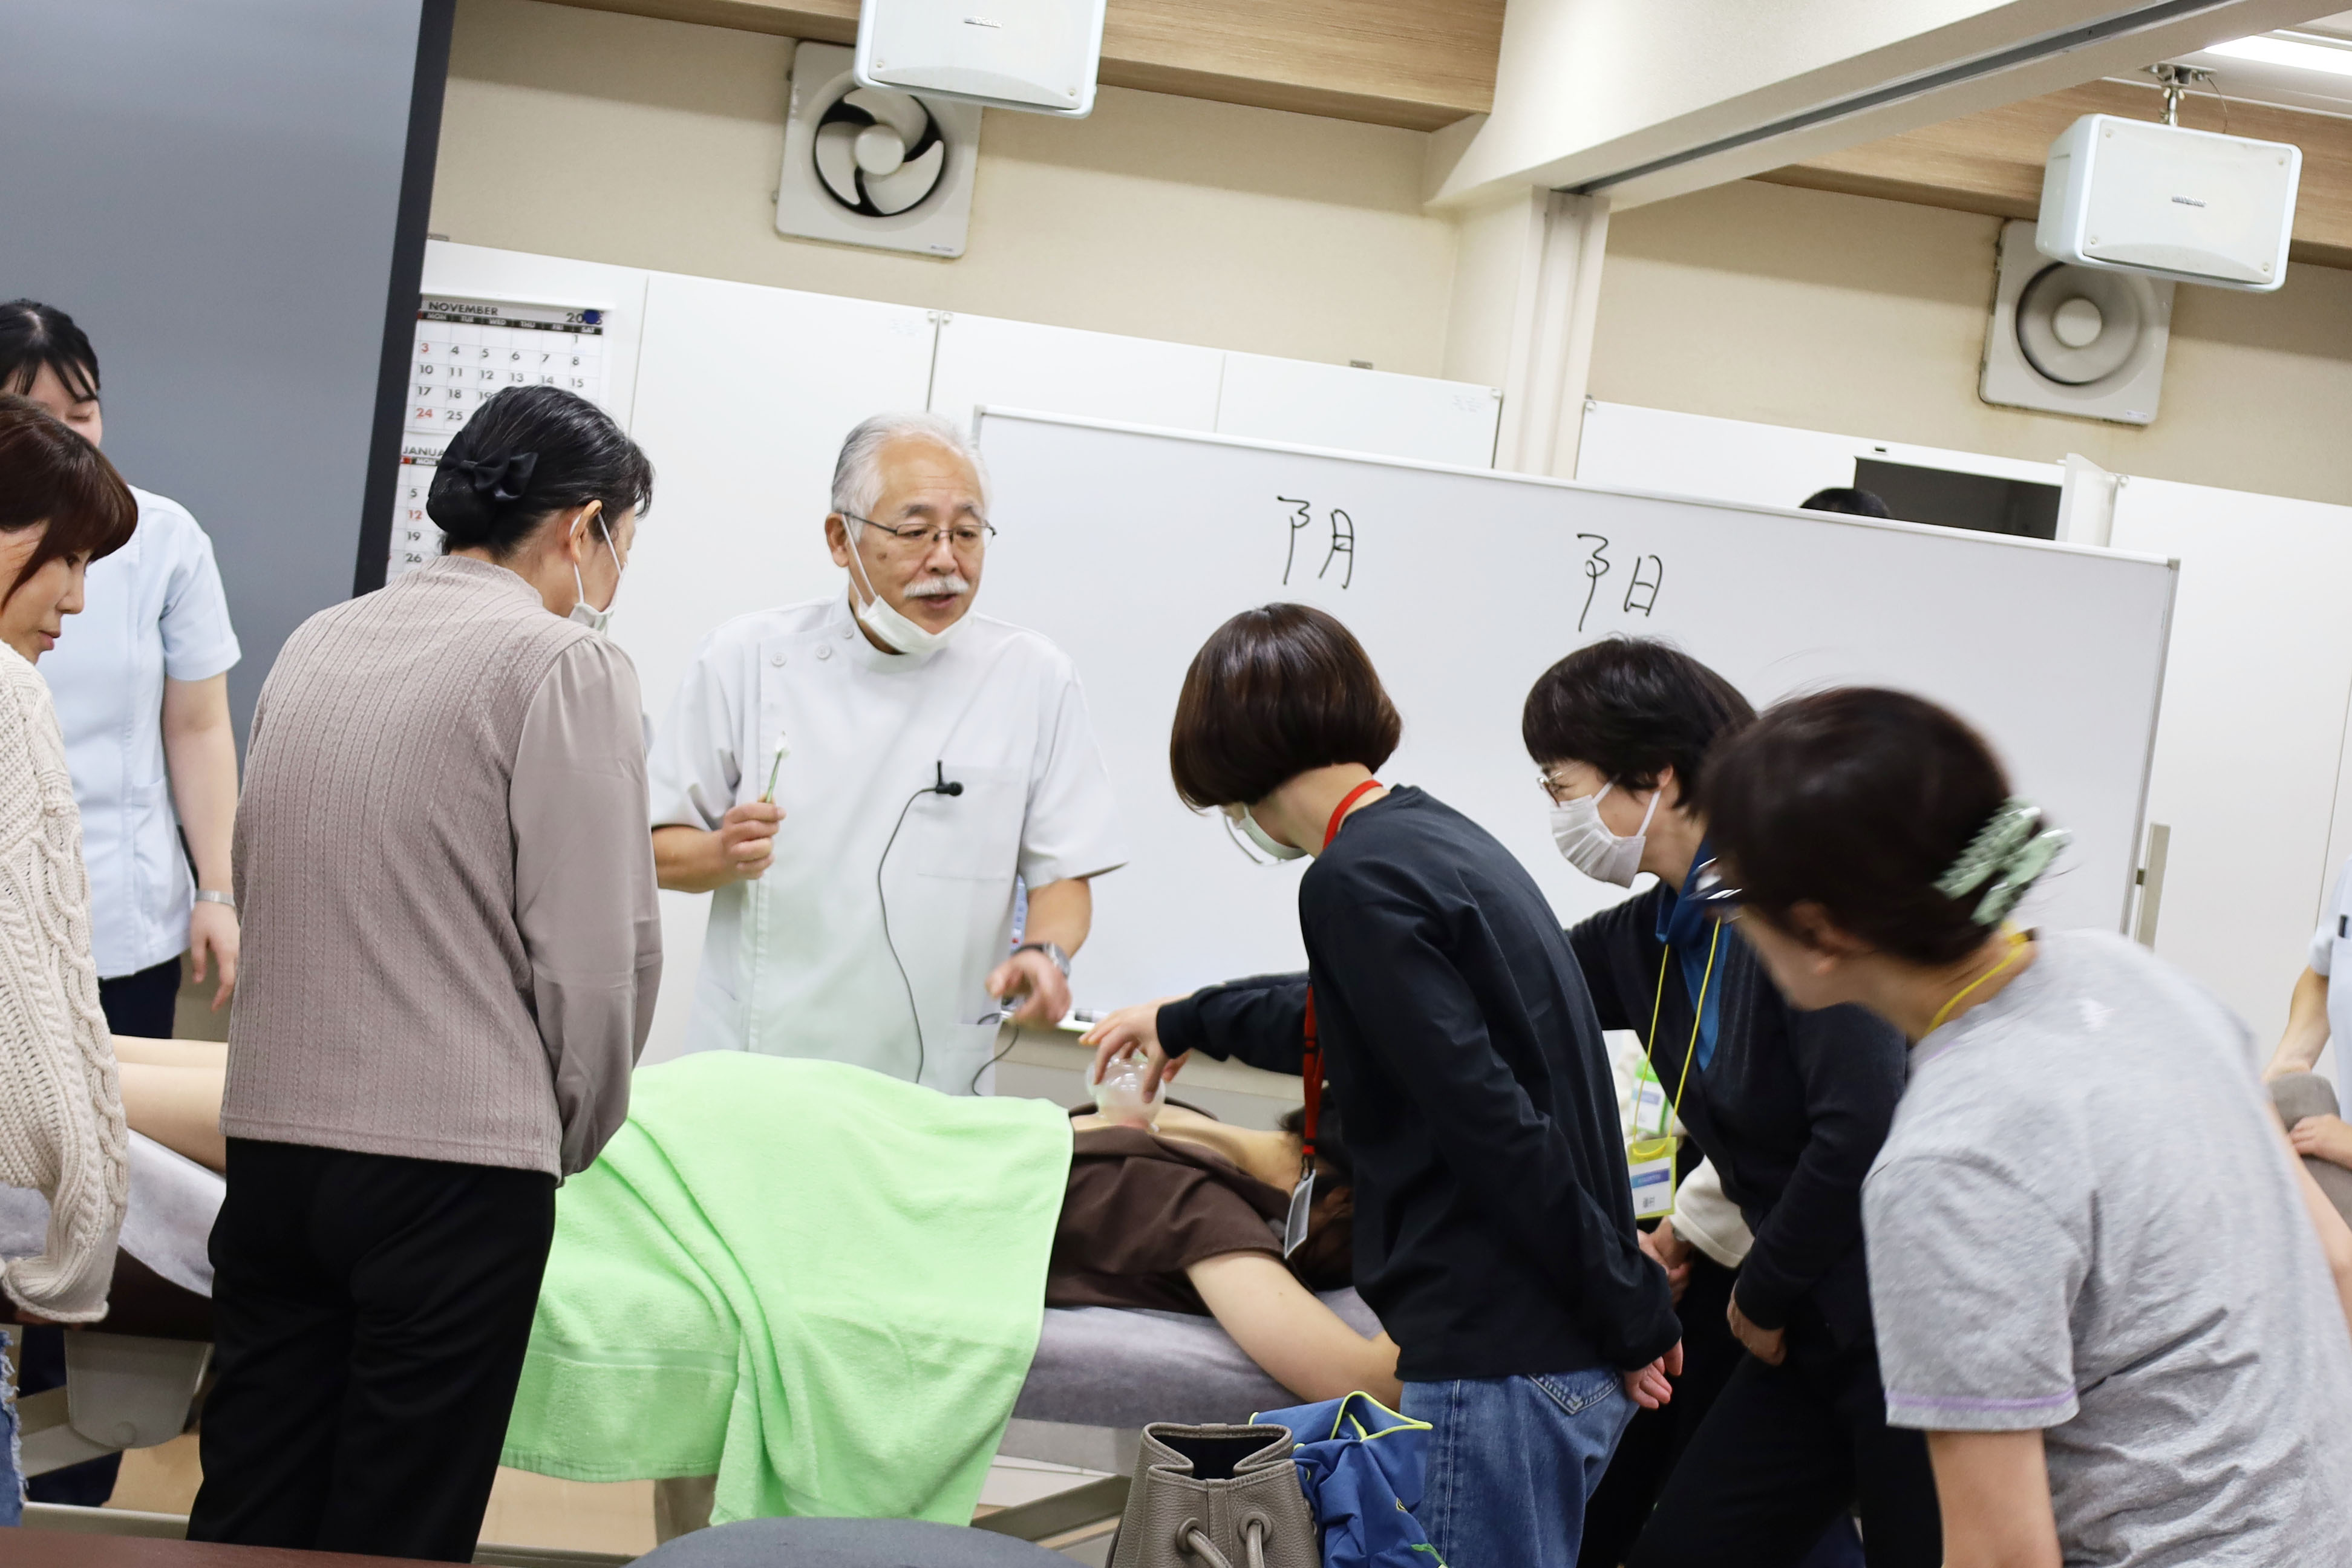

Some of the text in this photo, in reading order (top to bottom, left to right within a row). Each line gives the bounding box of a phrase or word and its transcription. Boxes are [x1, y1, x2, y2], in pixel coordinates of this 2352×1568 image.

[428, 301, 498, 315] NOVEMBER
[574, 335, 578, 344] 1
[421, 343, 580, 365] 3 4 5 6 7 8
[420, 364, 584, 387] 10 11 12 13 14 15
[418, 386, 432, 396] 17
[449, 388, 462, 399] 18
[416, 408, 463, 420] 24 25
[403, 446, 445, 456] JANUA
[410, 488, 417, 498] 5
[408, 510, 422, 520] 12
[407, 531, 420, 541] 19
[405, 553, 422, 563] 26
